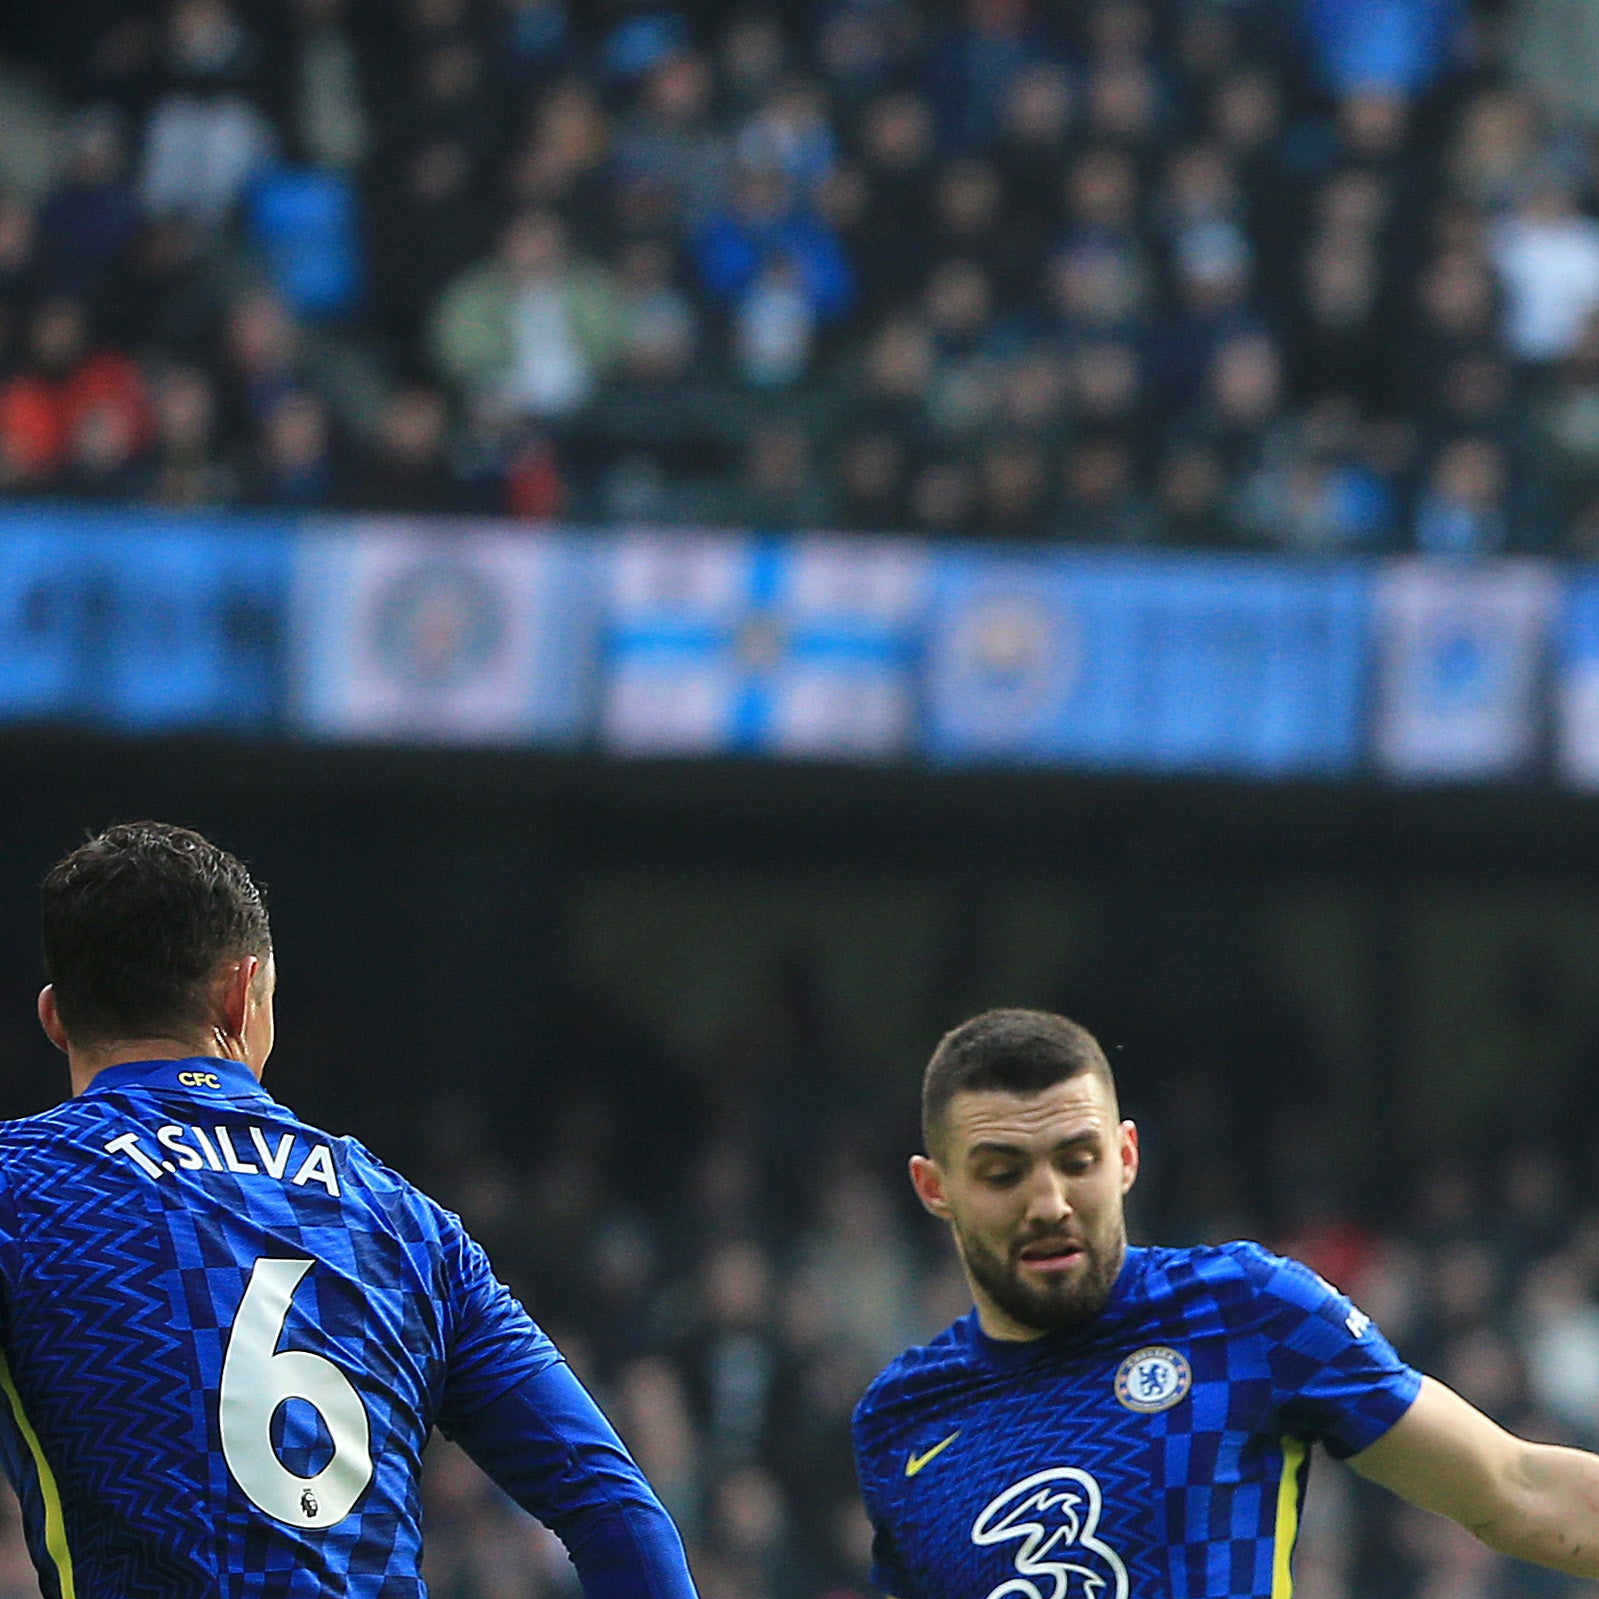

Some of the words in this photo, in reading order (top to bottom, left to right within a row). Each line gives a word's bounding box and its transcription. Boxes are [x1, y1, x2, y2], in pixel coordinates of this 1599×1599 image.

[179, 1071, 221, 1090] CFC
[104, 1125, 341, 1198] T.SILVA
[219, 1257, 374, 1529] 6
